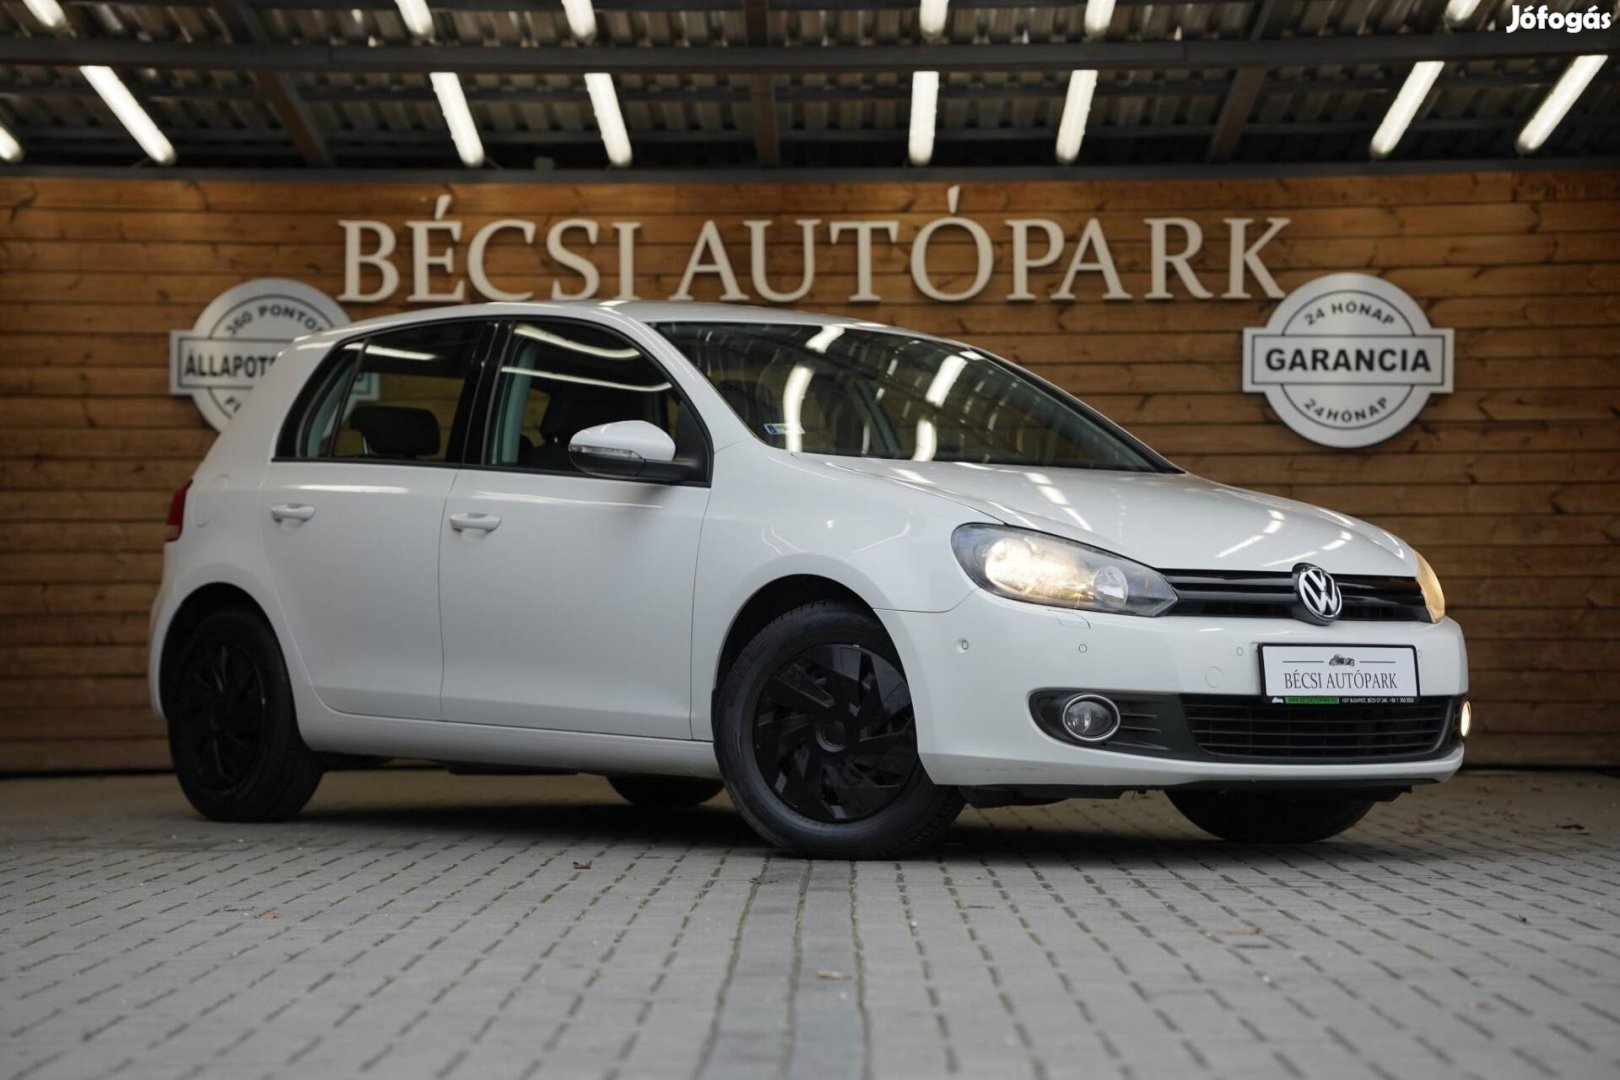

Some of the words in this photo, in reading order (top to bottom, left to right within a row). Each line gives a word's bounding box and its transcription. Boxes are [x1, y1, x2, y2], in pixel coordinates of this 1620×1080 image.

[337, 194, 642, 302] BÉCSI
[669, 185, 1290, 301] AUTÓPARK
[1304, 311, 1326, 326] 24
[1265, 348, 1431, 372] GARANCIA
[1300, 568, 1338, 616] VW
[1284, 669, 1322, 689] BÉCSI
[1326, 669, 1398, 689] AUTÓPARK
